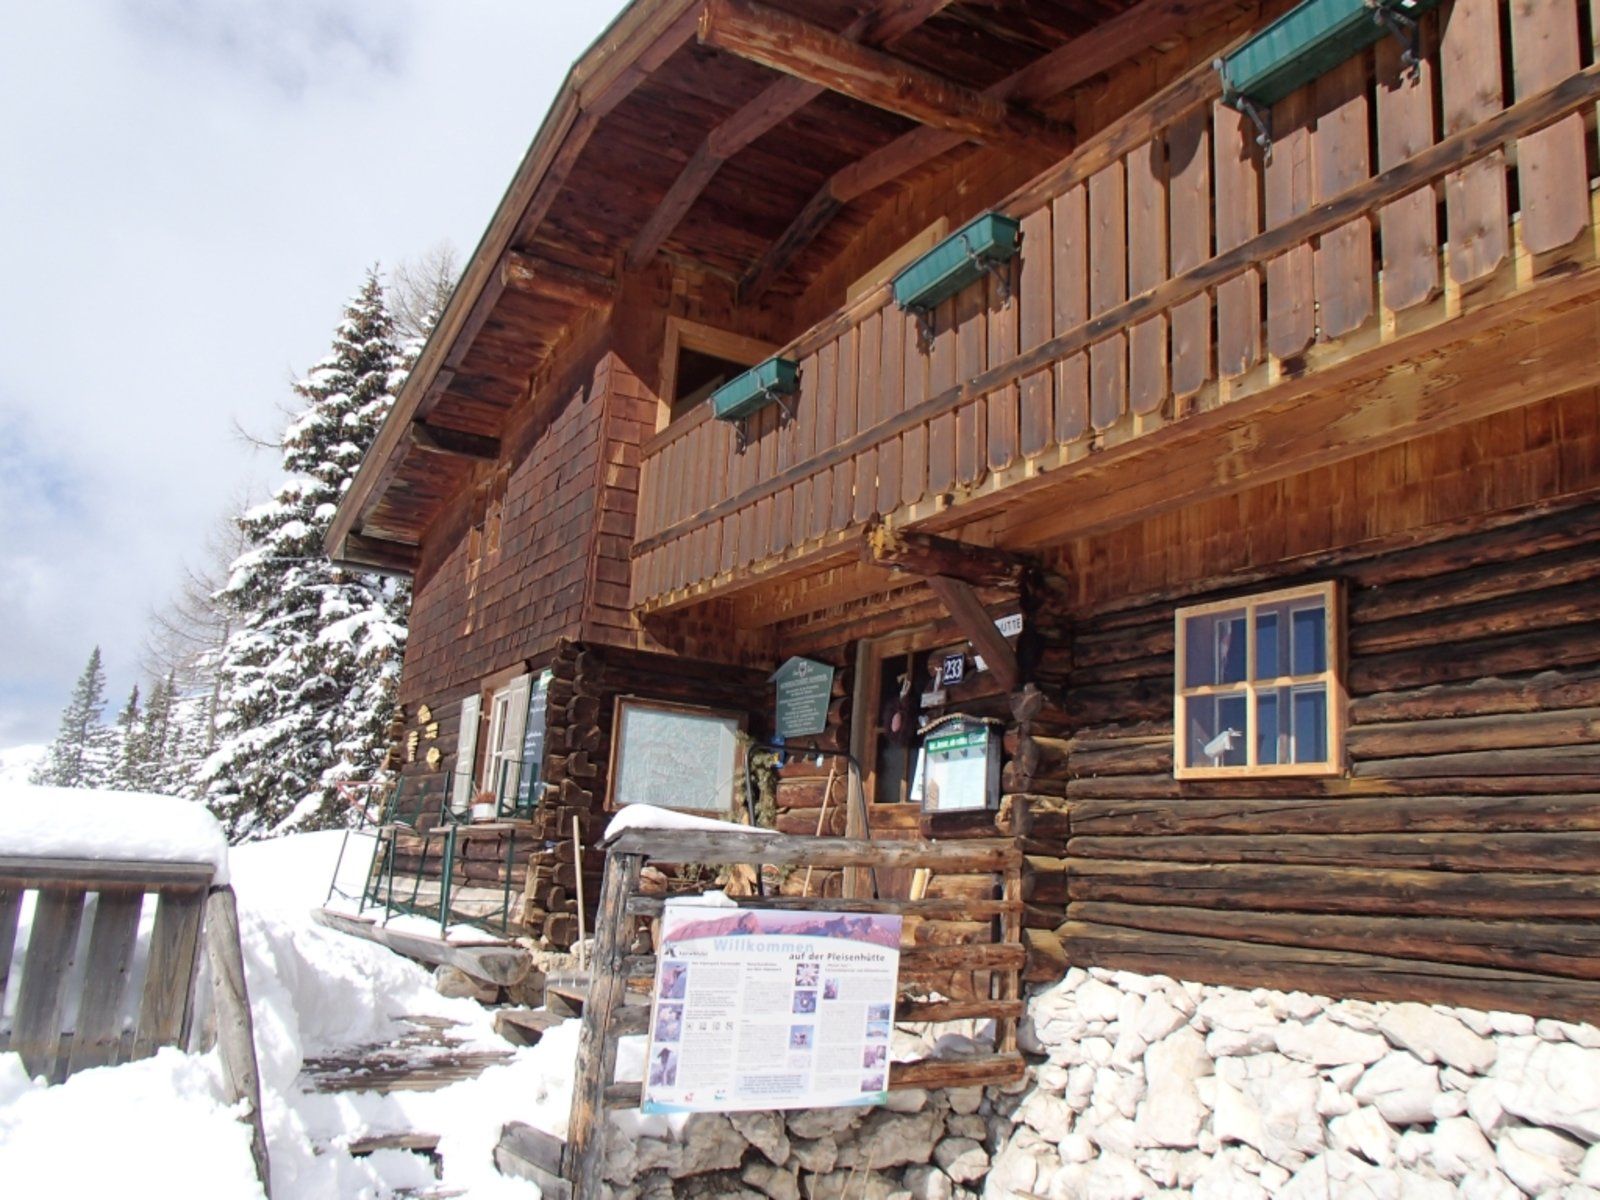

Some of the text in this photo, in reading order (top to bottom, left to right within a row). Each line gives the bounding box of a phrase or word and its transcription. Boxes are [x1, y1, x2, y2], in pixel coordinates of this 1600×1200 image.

[944, 658, 962, 680] 233
[713, 938, 814, 953] Willkommen
[789, 952, 806, 960] auf
[808, 952, 824, 961] der
